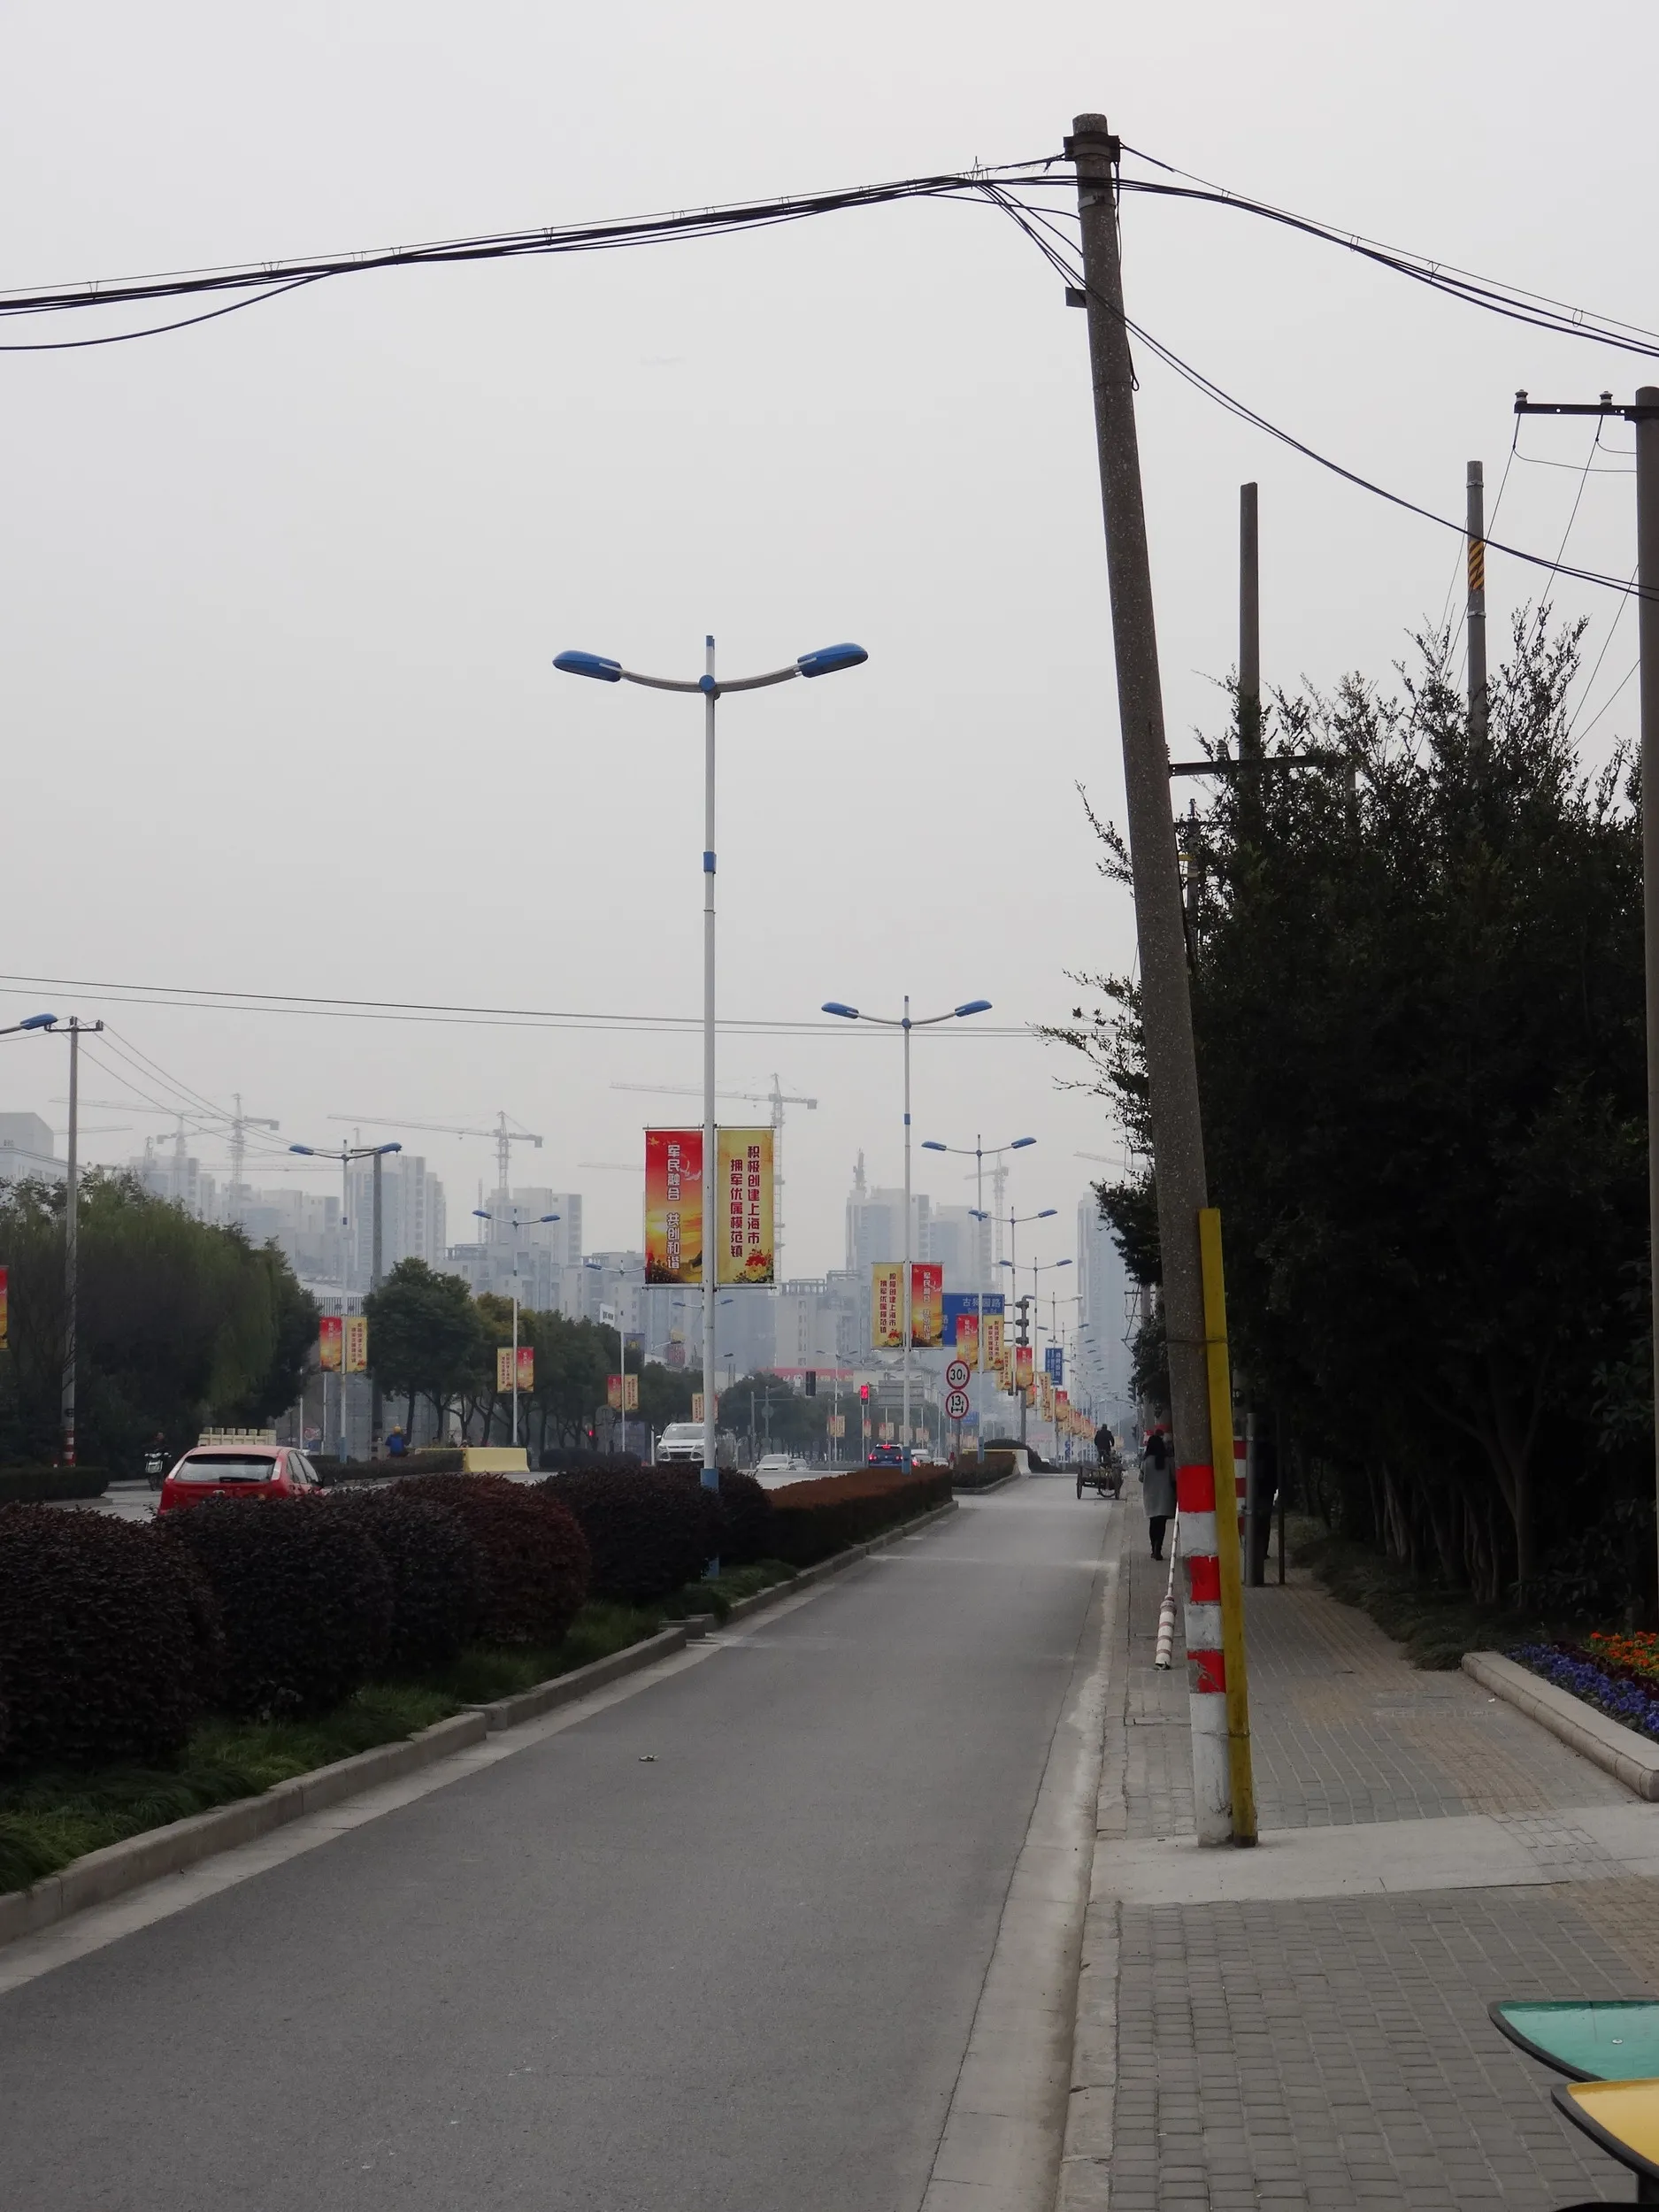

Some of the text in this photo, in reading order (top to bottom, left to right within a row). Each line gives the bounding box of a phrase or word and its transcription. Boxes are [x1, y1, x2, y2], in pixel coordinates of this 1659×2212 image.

[666, 1144, 680, 1270] 军民融合 共创和谐
[730, 1159, 743, 1257] 拥军优属模范镇
[747, 1145, 760, 1245] 积极创建上海市
[949, 1368, 966, 1380] 30t
[950, 1394, 964, 1407] 13t
